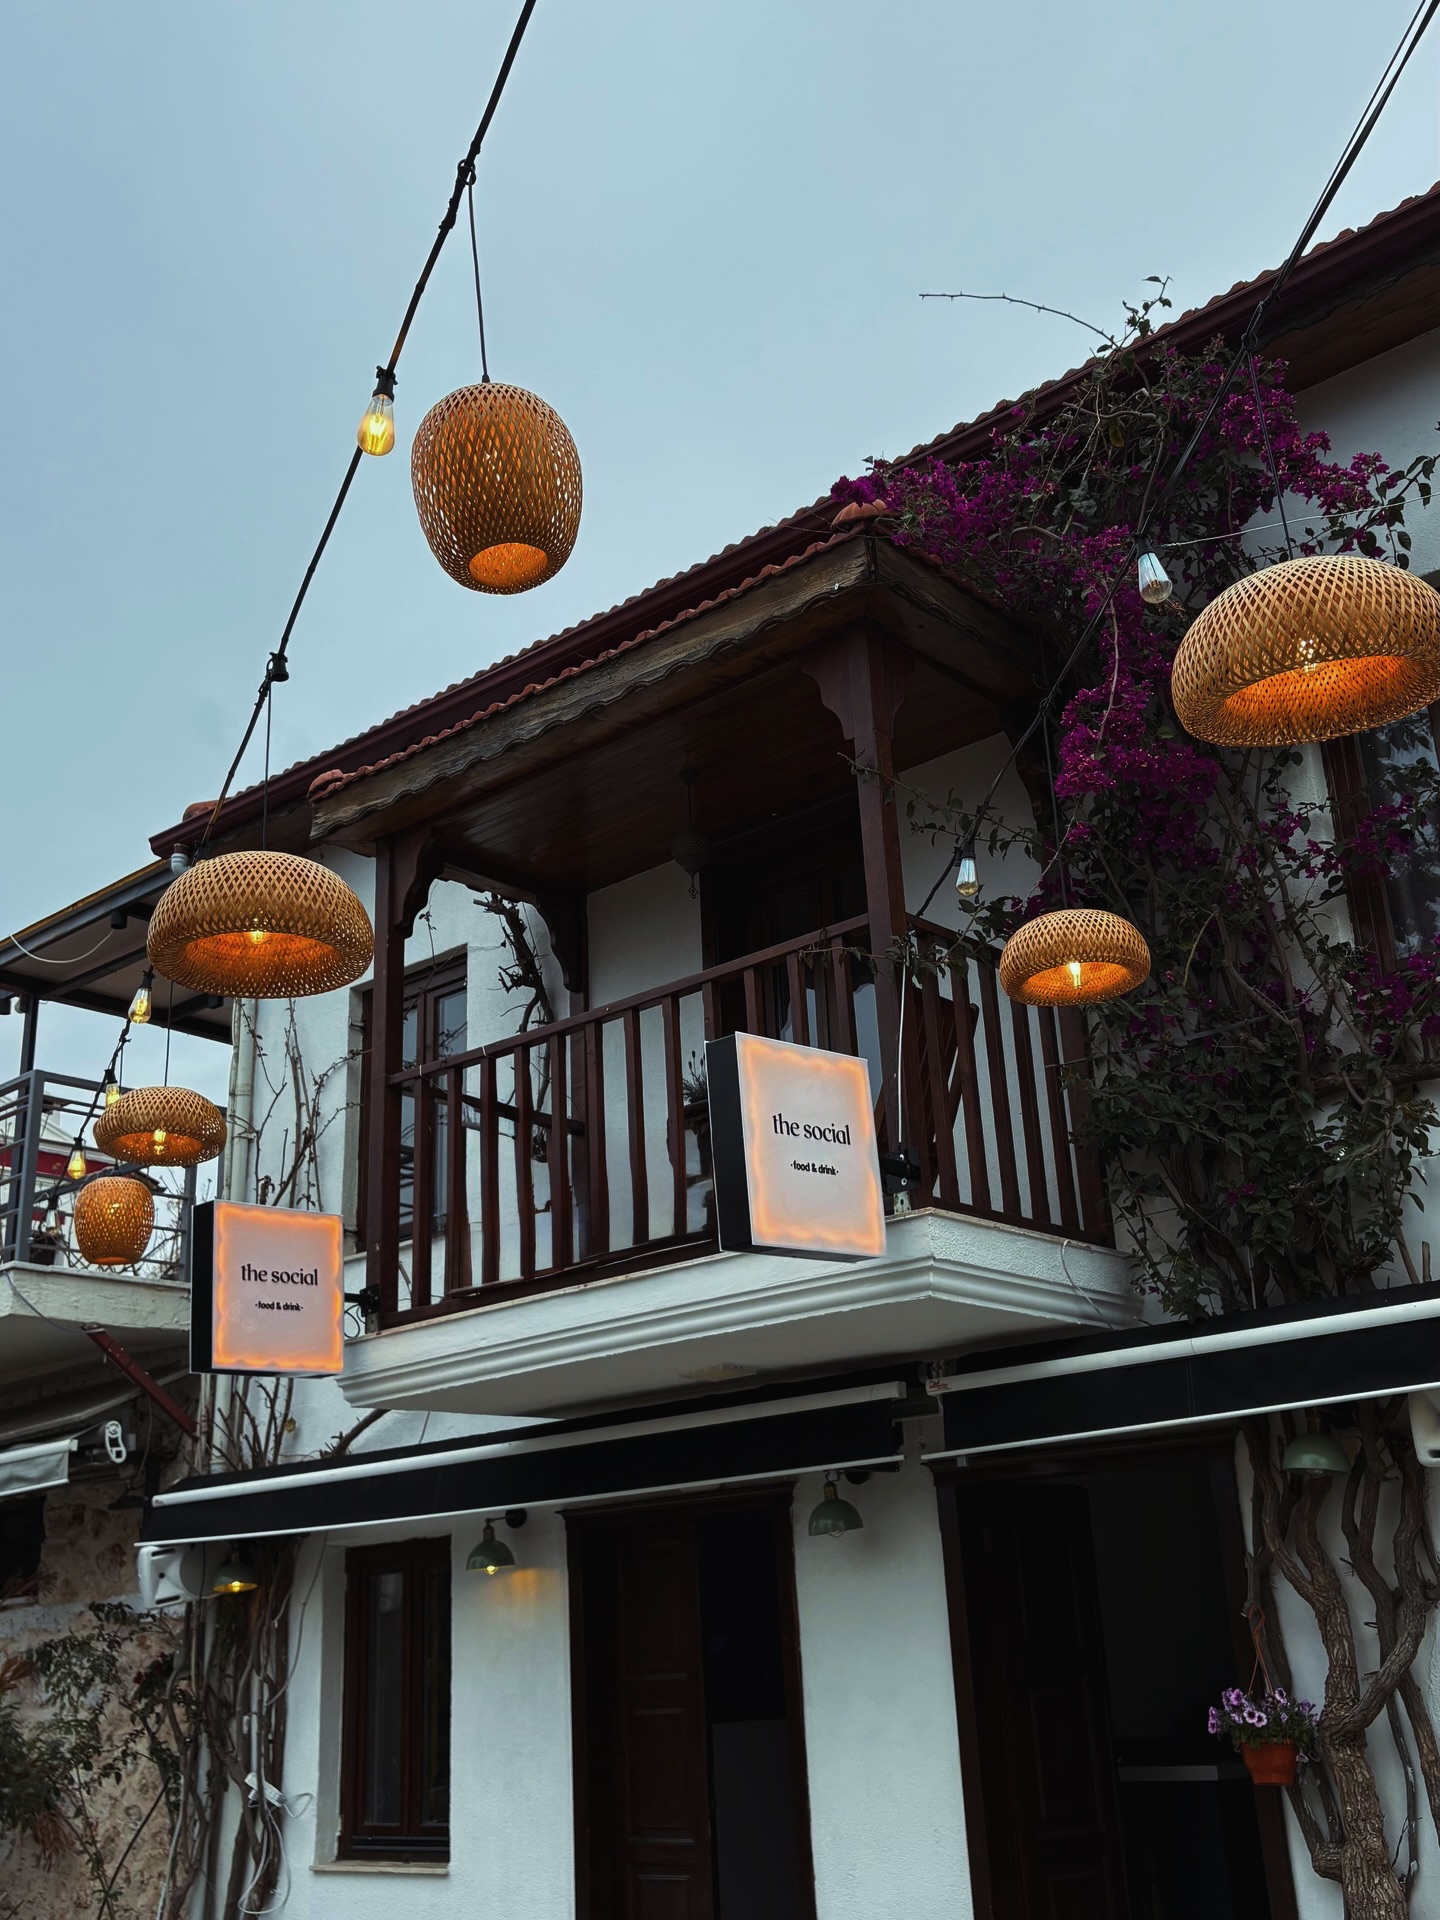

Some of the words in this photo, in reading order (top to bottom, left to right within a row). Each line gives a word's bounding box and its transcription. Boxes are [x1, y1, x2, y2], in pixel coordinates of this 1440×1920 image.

[772, 1112, 800, 1137] the
[803, 1123, 851, 1146] social
[811, 1163, 817, 1173] &
[241, 1263, 268, 1282] the
[271, 1268, 318, 1286] social
[276, 1301, 282, 1311] &
